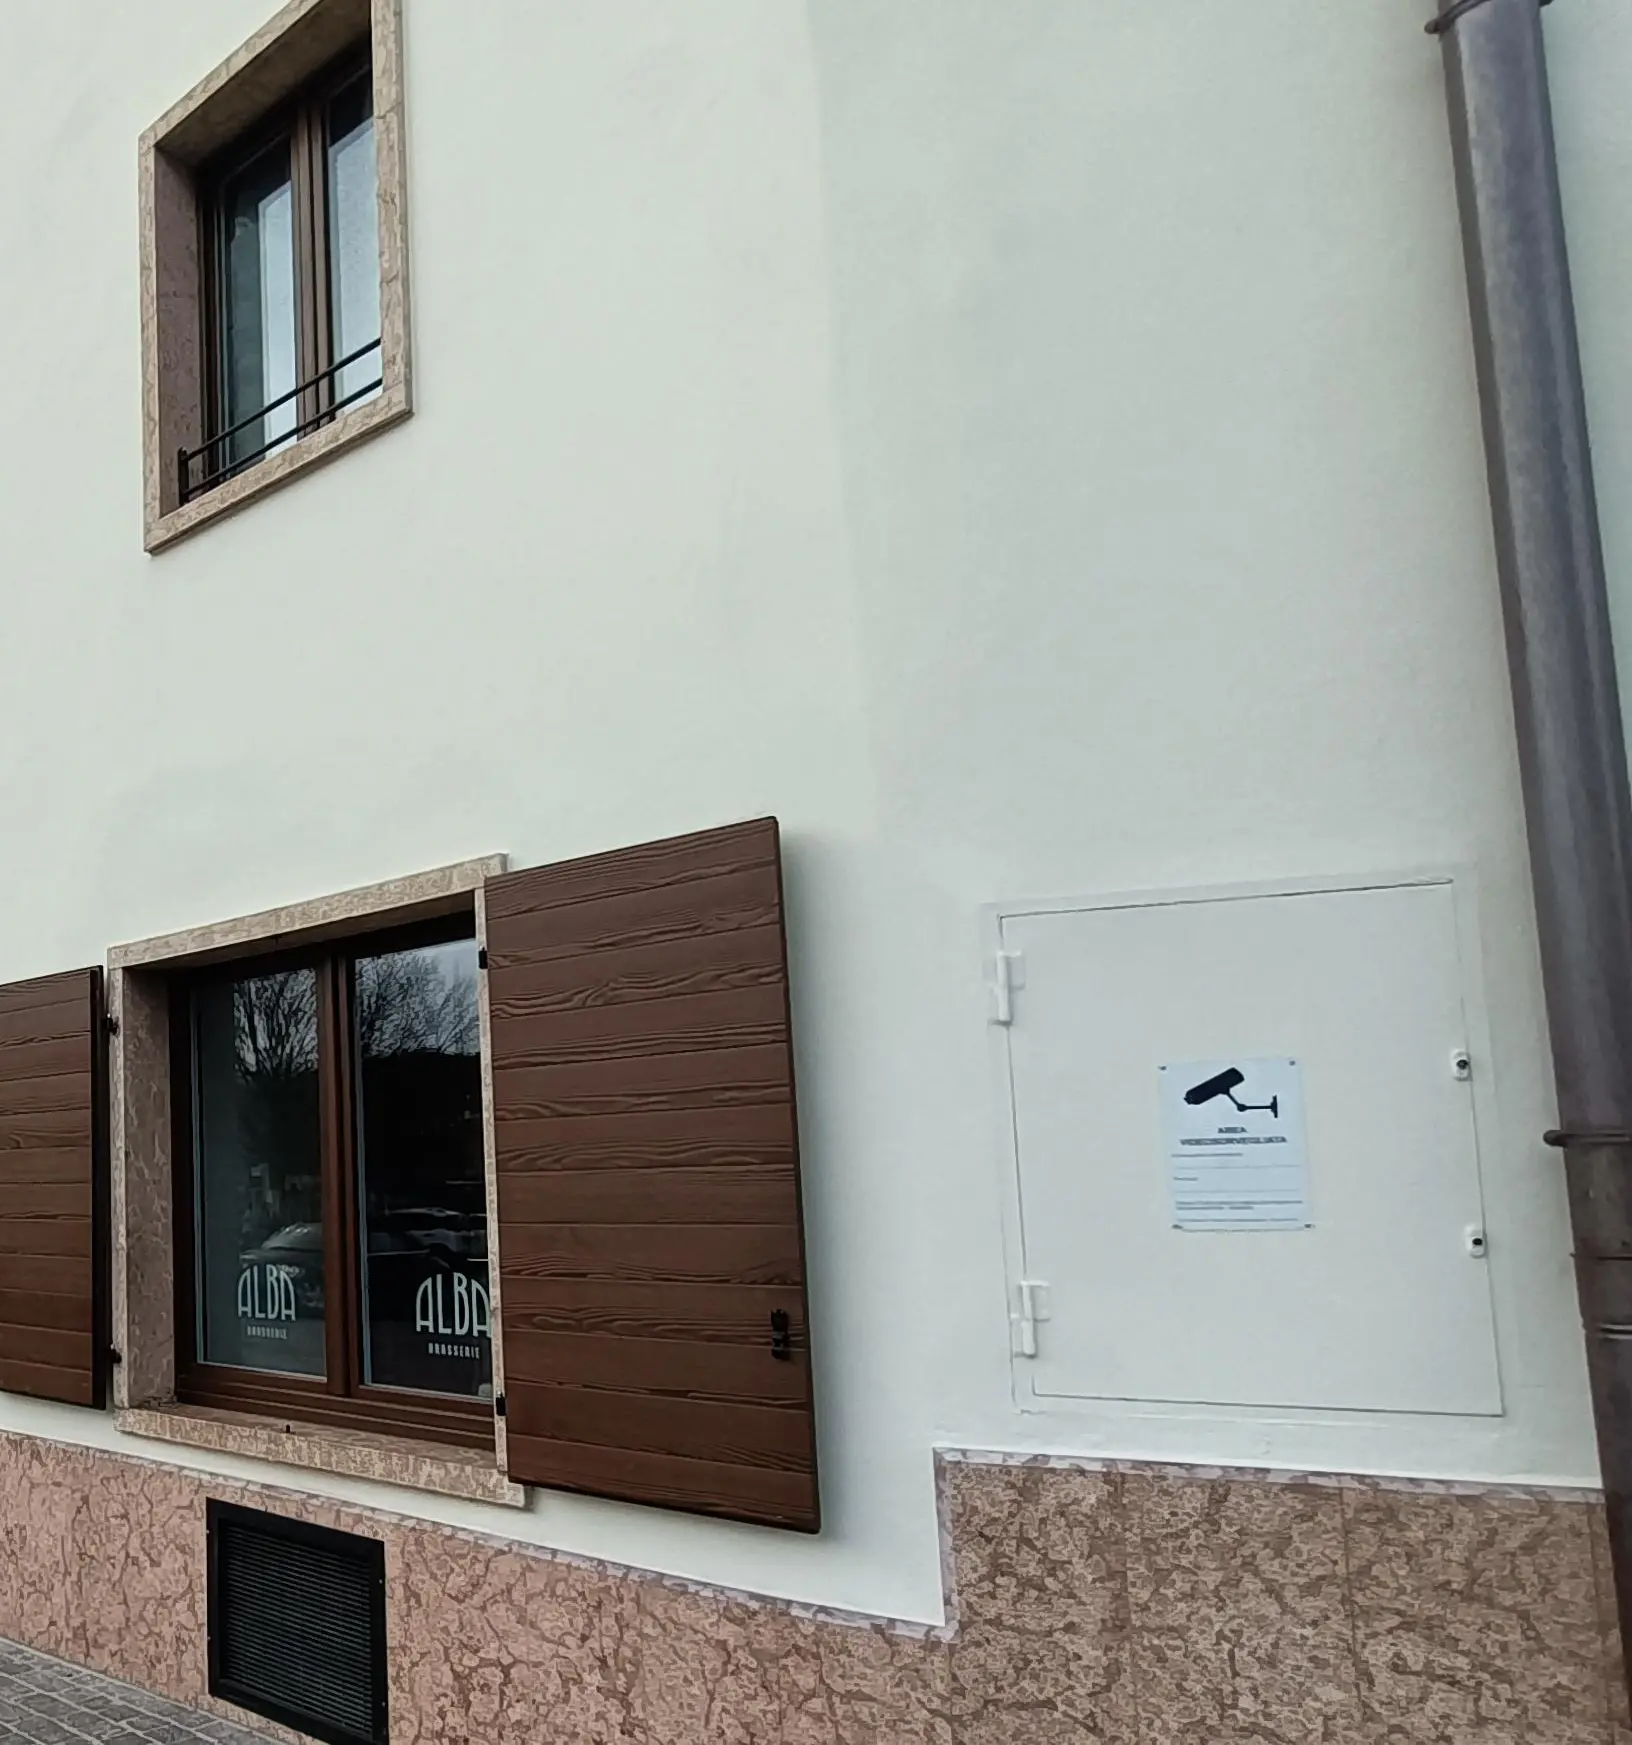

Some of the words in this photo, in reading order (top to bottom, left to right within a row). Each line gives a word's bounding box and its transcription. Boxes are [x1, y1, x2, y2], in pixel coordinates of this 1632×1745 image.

[237, 1263, 297, 1322] ALBA
[415, 1271, 492, 1339] ALBA
[428, 1342, 481, 1360] BRASSERIE
